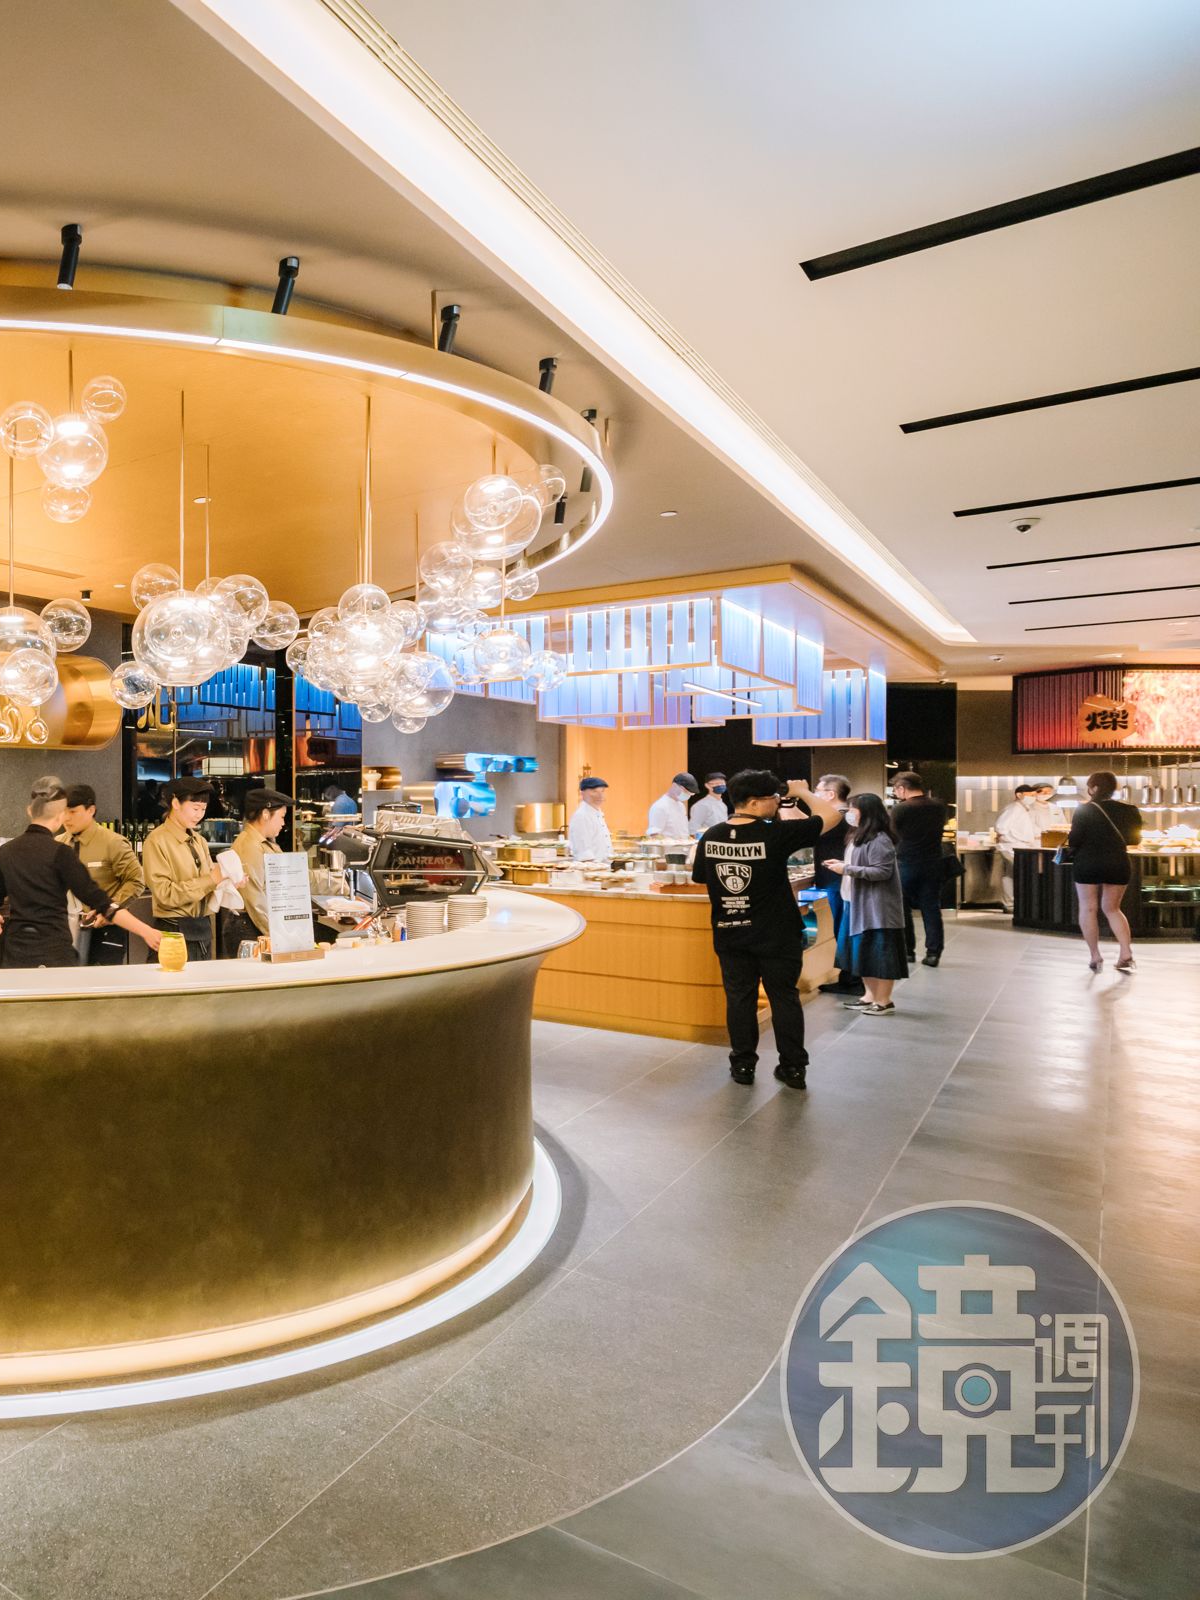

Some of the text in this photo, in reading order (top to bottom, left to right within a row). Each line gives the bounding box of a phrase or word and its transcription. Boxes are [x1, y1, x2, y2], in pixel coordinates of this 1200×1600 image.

[706, 844, 762, 857] BROOKLYN
[398, 855, 455, 865] SANREMO
[718, 864, 750, 878] NETS
